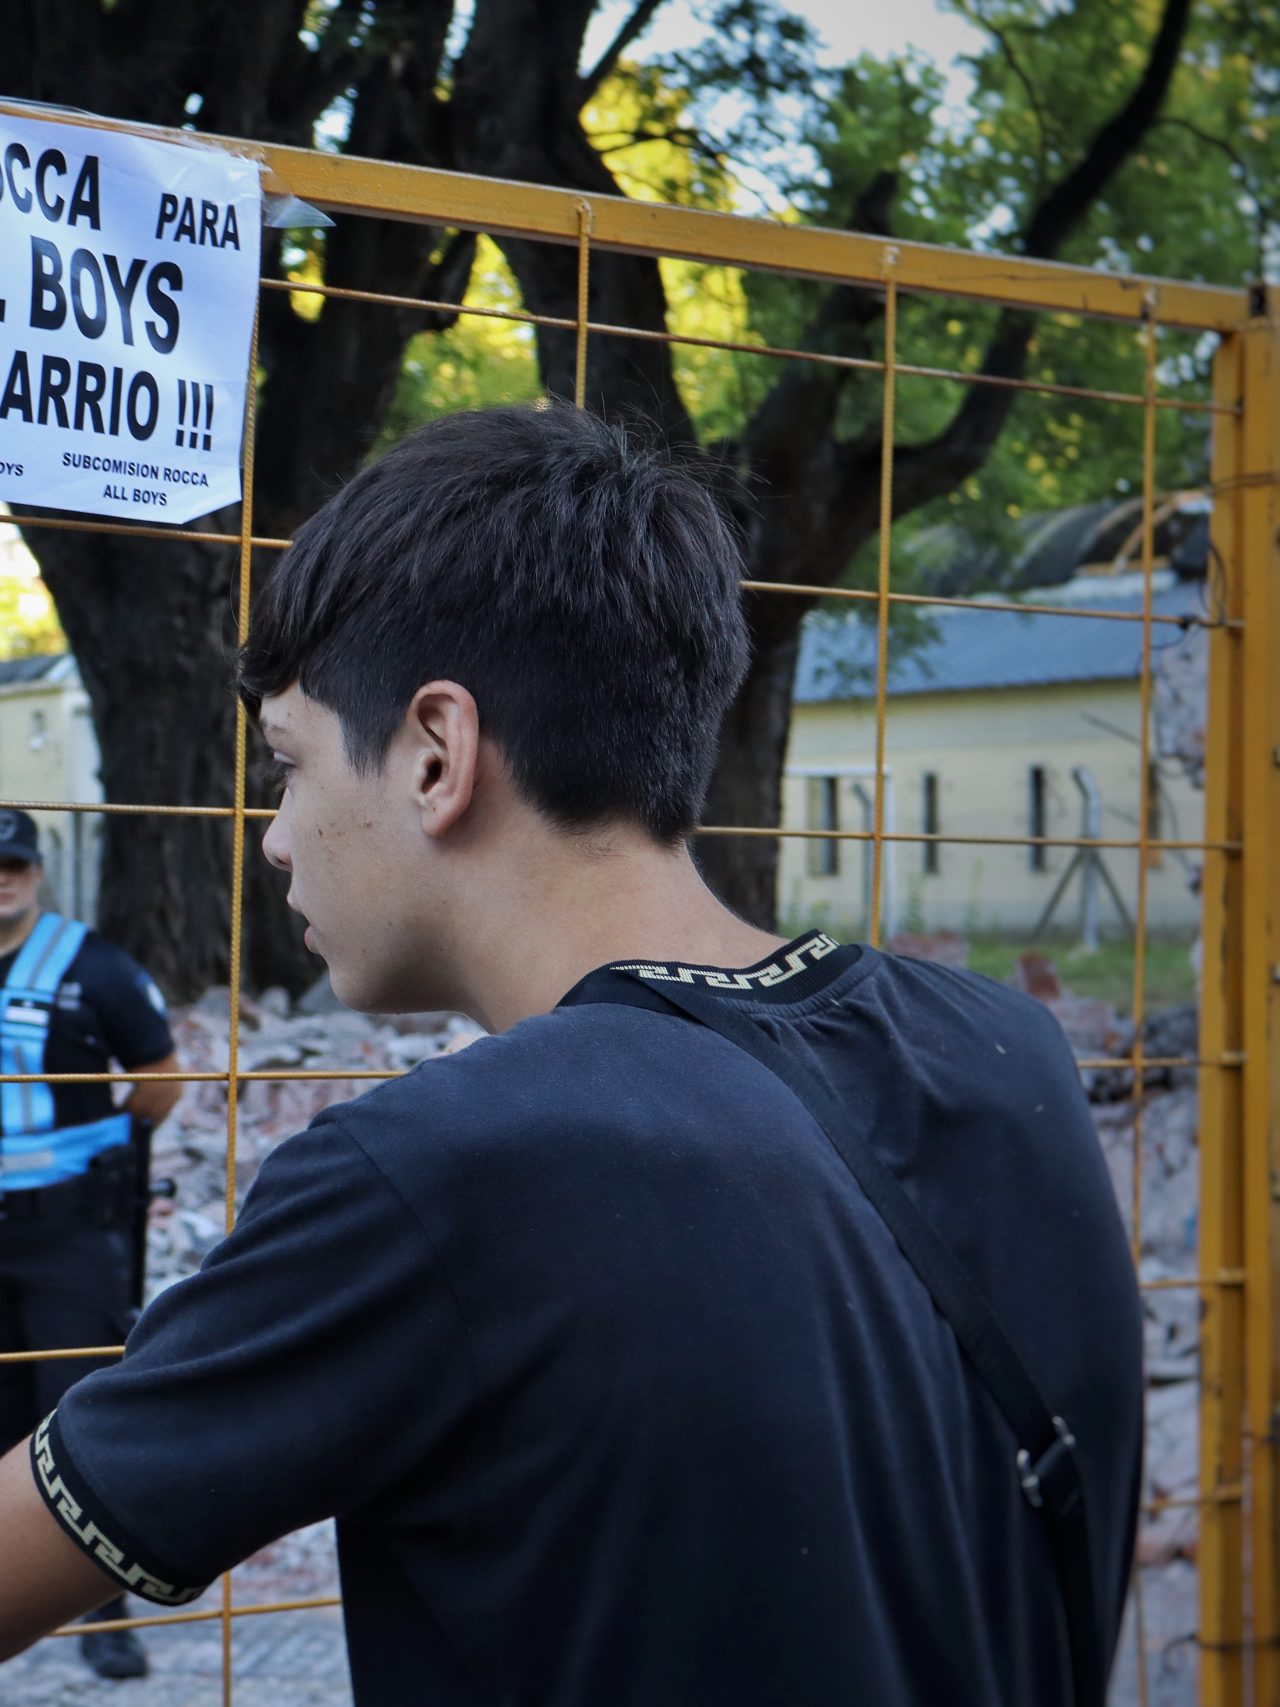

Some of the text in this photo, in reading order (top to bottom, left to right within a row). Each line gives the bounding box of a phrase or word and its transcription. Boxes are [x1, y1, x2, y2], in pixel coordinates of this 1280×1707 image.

[154, 192, 241, 251] PARA
[29, 236, 184, 355] BOYS
[175, 378, 214, 452] !!!
[62, 451, 209, 487] SUBCOMISION ROCCA
[103, 484, 168, 506] ALL BOYS
